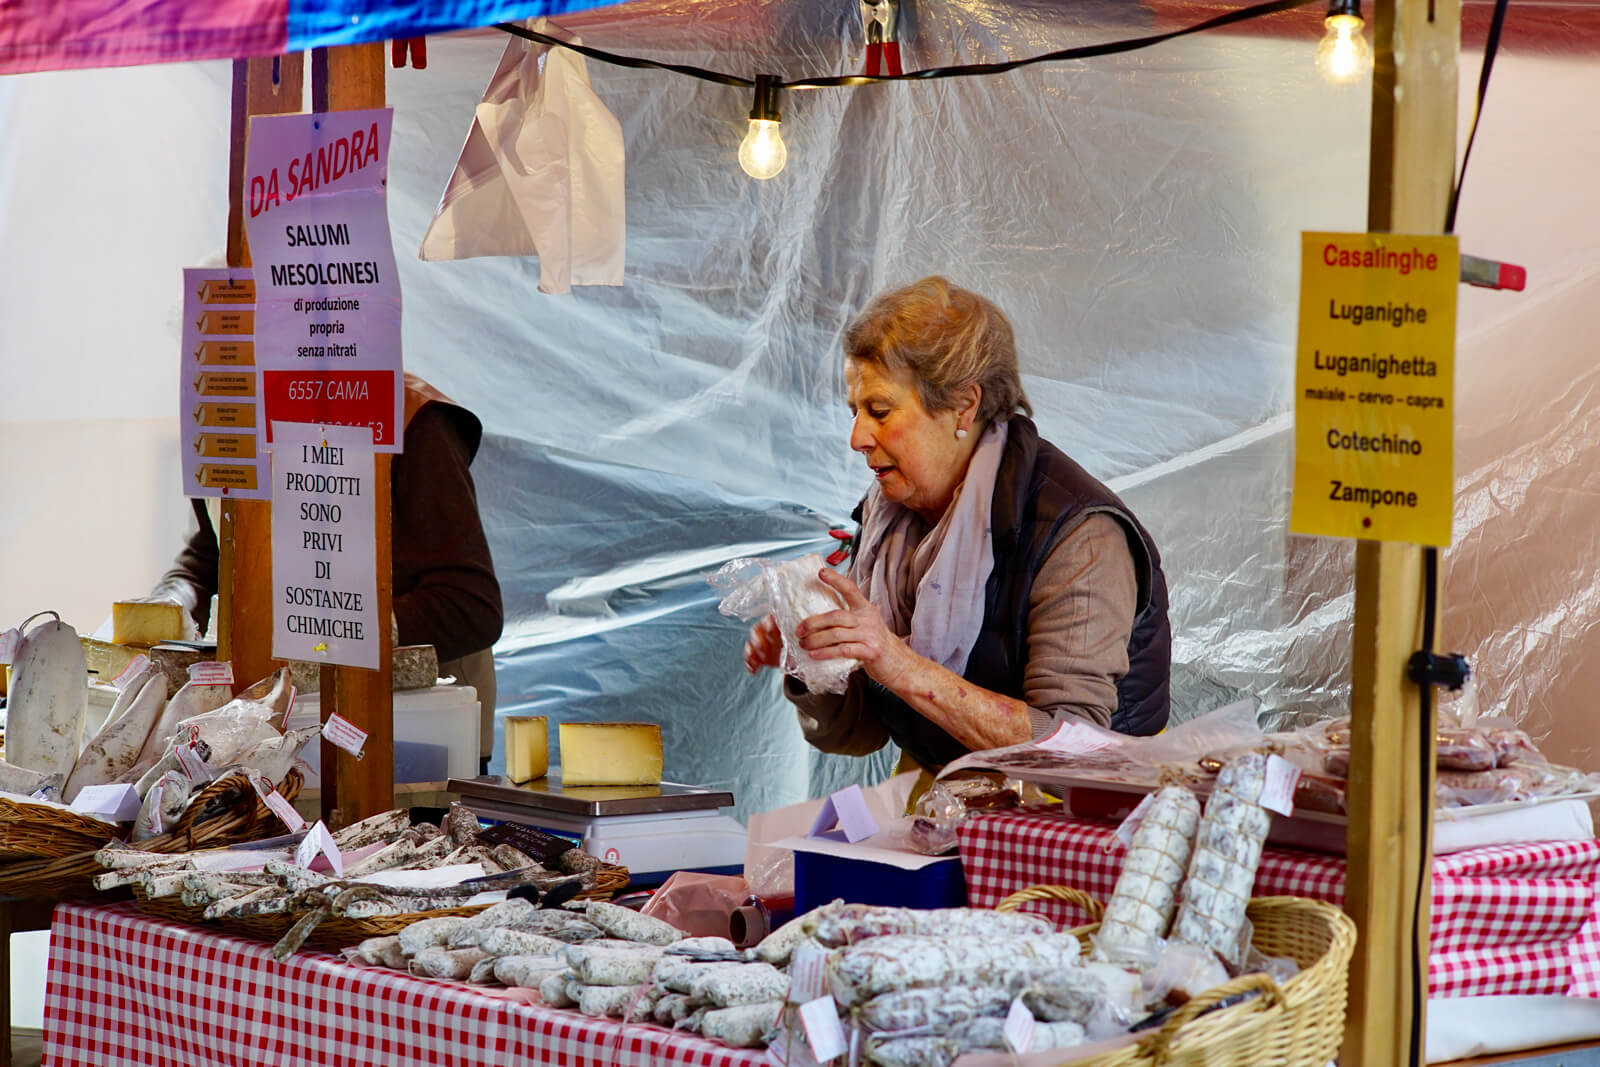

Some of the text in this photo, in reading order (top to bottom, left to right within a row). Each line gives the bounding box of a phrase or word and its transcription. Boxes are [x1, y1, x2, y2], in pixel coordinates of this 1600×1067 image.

[250, 122, 379, 217] DA SANDRA
[285, 223, 350, 247] SALUMI
[1323, 243, 1438, 275] Casalinghe
[270, 261, 380, 286] MESOLCINESI
[293, 297, 360, 314] di produzione
[1329, 299, 1427, 328] Luganighe
[309, 319, 345, 338] propria
[297, 343, 357, 358] senza nitrati
[1314, 350, 1437, 380] Luganighetta
[288, 380, 369, 401] 6557 CAMA
[1305, 388, 1345, 401] maiale
[1358, 392, 1394, 405] cervo
[1406, 395, 1444, 409] capra
[1326, 429, 1422, 456] Cotechino
[302, 444, 344, 466] I MIEI
[286, 472, 361, 496] PRODOTTI
[1329, 480, 1418, 509] Zampone
[300, 502, 342, 523] SONO
[303, 531, 343, 553] PRIVI
[315, 560, 331, 580] DI
[286, 586, 363, 612] SOSTANZE
[286, 614, 364, 641] CHIMICHE
